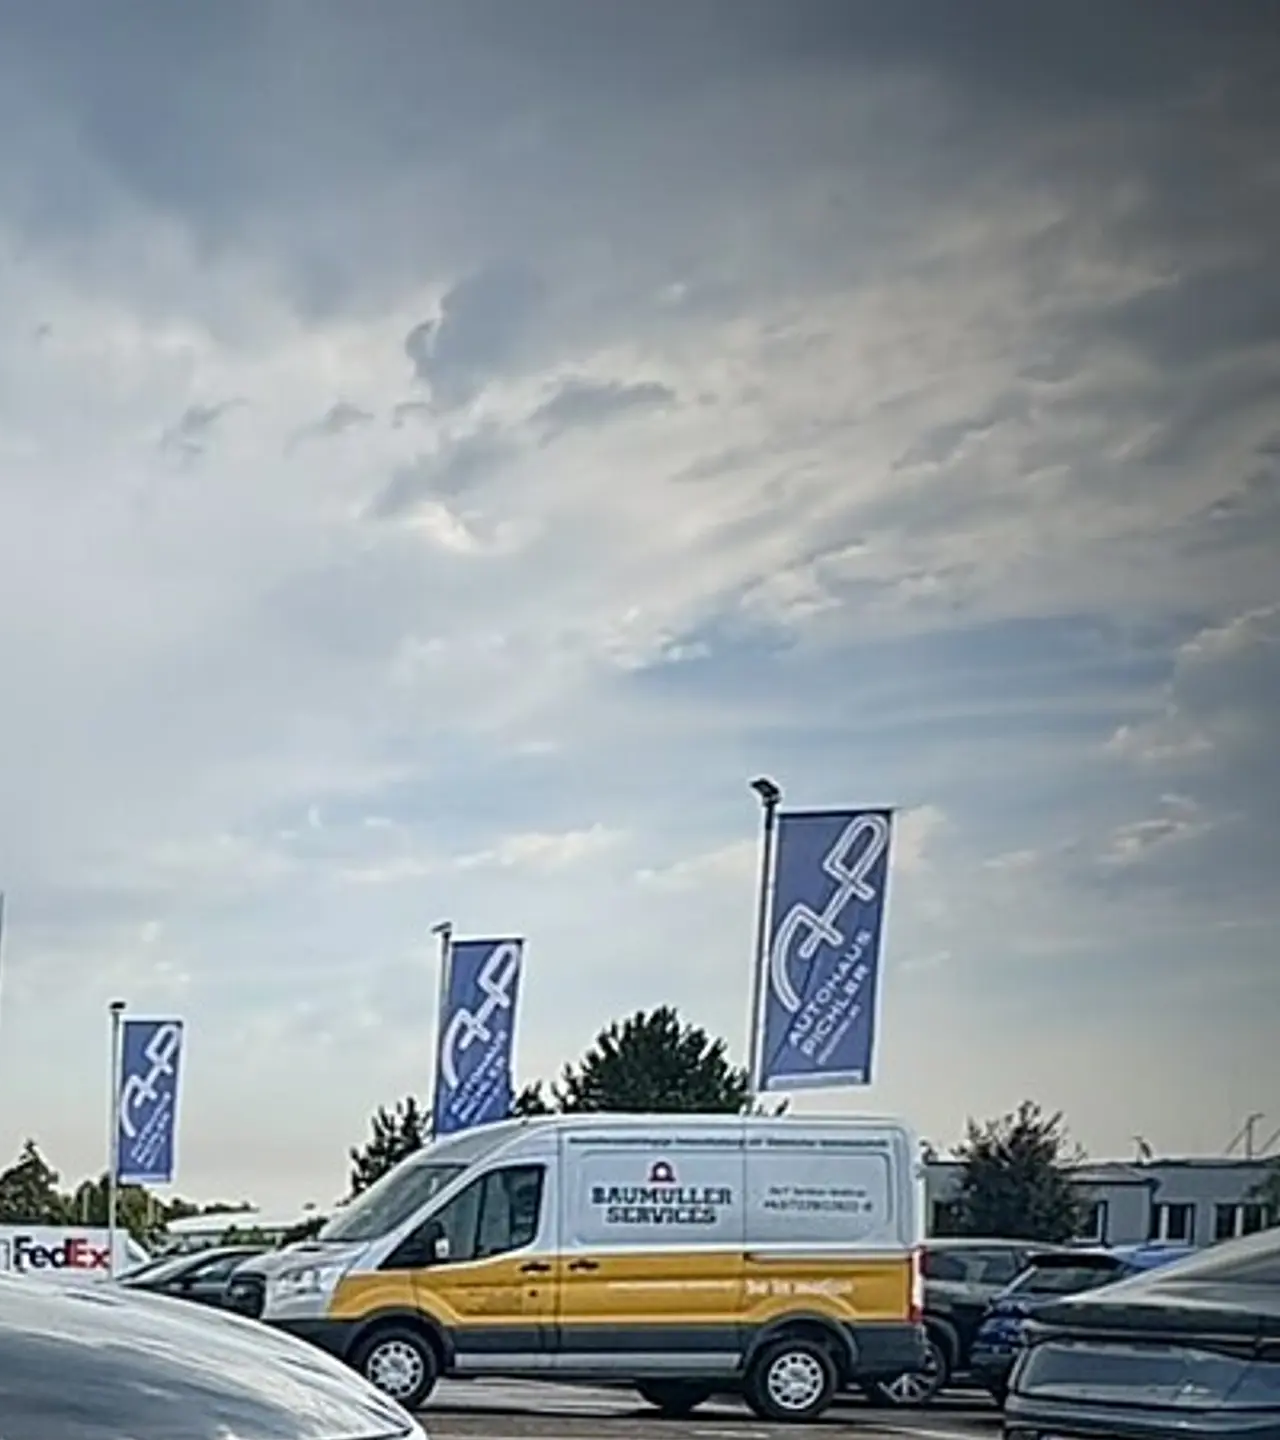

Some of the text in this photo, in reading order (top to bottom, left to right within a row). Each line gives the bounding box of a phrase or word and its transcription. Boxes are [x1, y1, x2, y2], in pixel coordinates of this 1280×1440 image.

[789, 929, 872, 1047] AUTOHAUS
[800, 965, 869, 1056] PICHLER
[606, 1206, 717, 1224] SERVICES
[13, 1236, 111, 1271] FedEx
